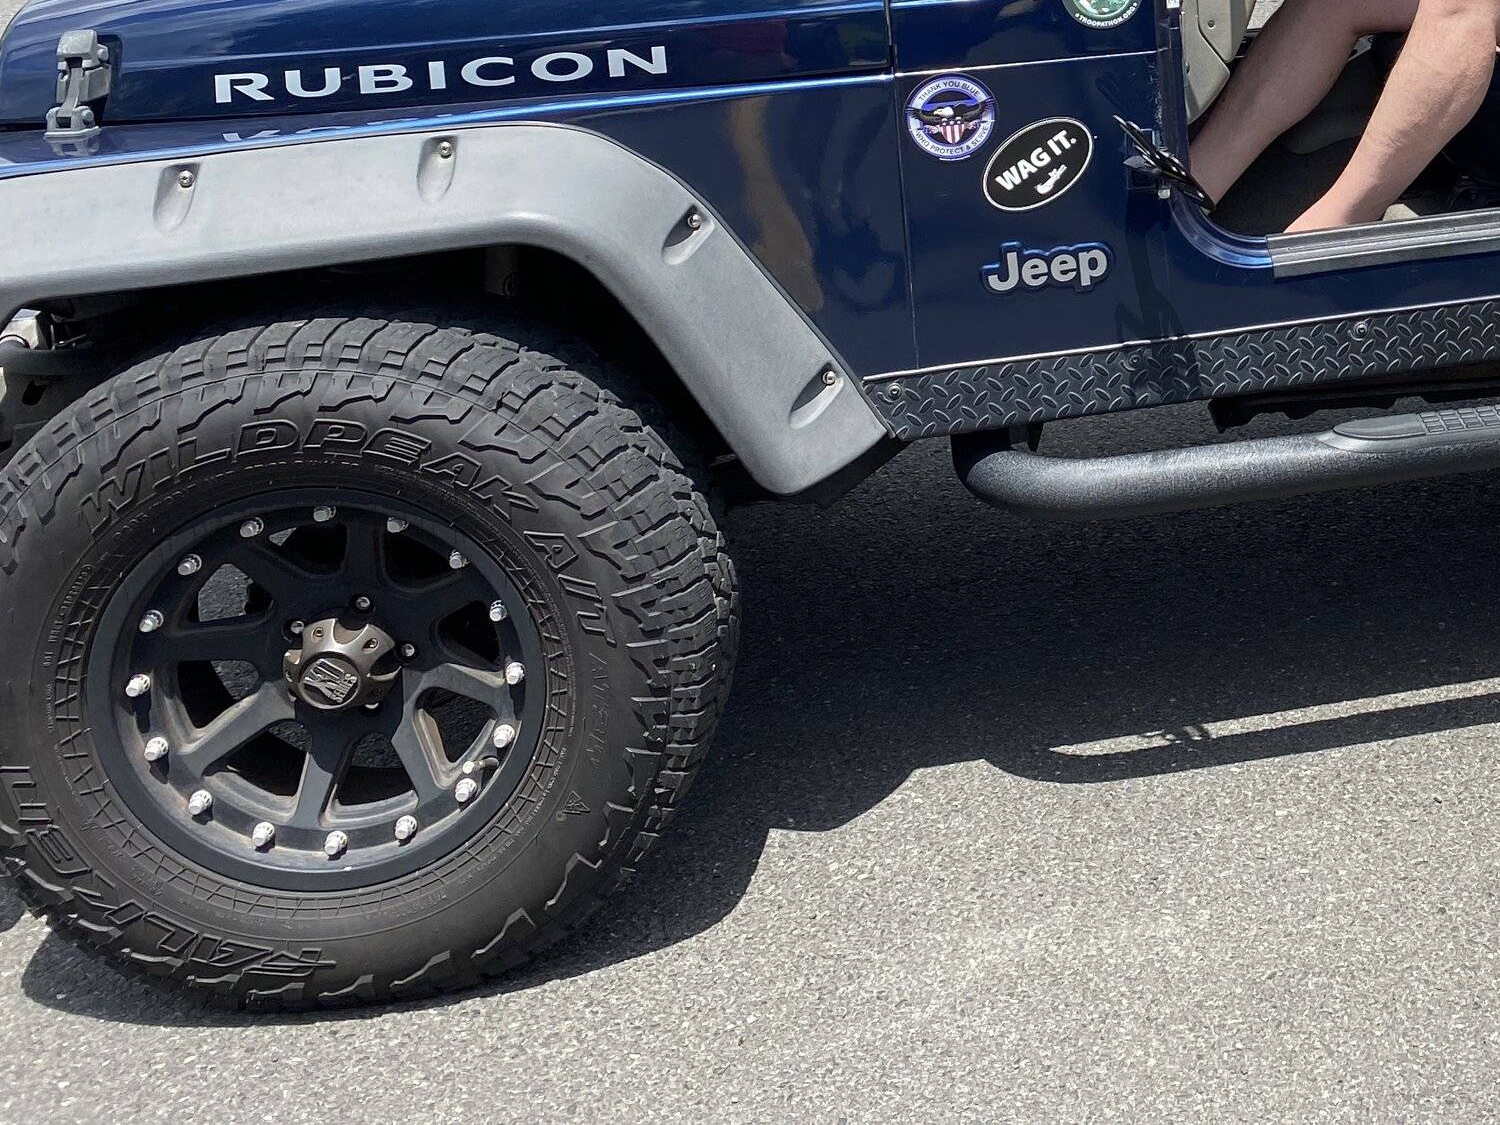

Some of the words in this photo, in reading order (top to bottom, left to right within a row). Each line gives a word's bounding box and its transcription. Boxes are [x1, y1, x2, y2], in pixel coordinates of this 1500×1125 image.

[215, 45, 668, 104] RUBICON
[918, 83, 941, 101] THANK
[943, 80, 960, 88] YOU
[961, 83, 981, 98] BLUE
[915, 129, 930, 147] WHO
[930, 144, 965, 155] PROTECT
[971, 126, 989, 146] SERVE
[995, 147, 1052, 192] WAG
[1049, 129, 1077, 155] IT.
[987, 248, 1108, 293] Jeep
[78, 418, 539, 535] WILDPEAK
[330, 673, 358, 703] SERIES
